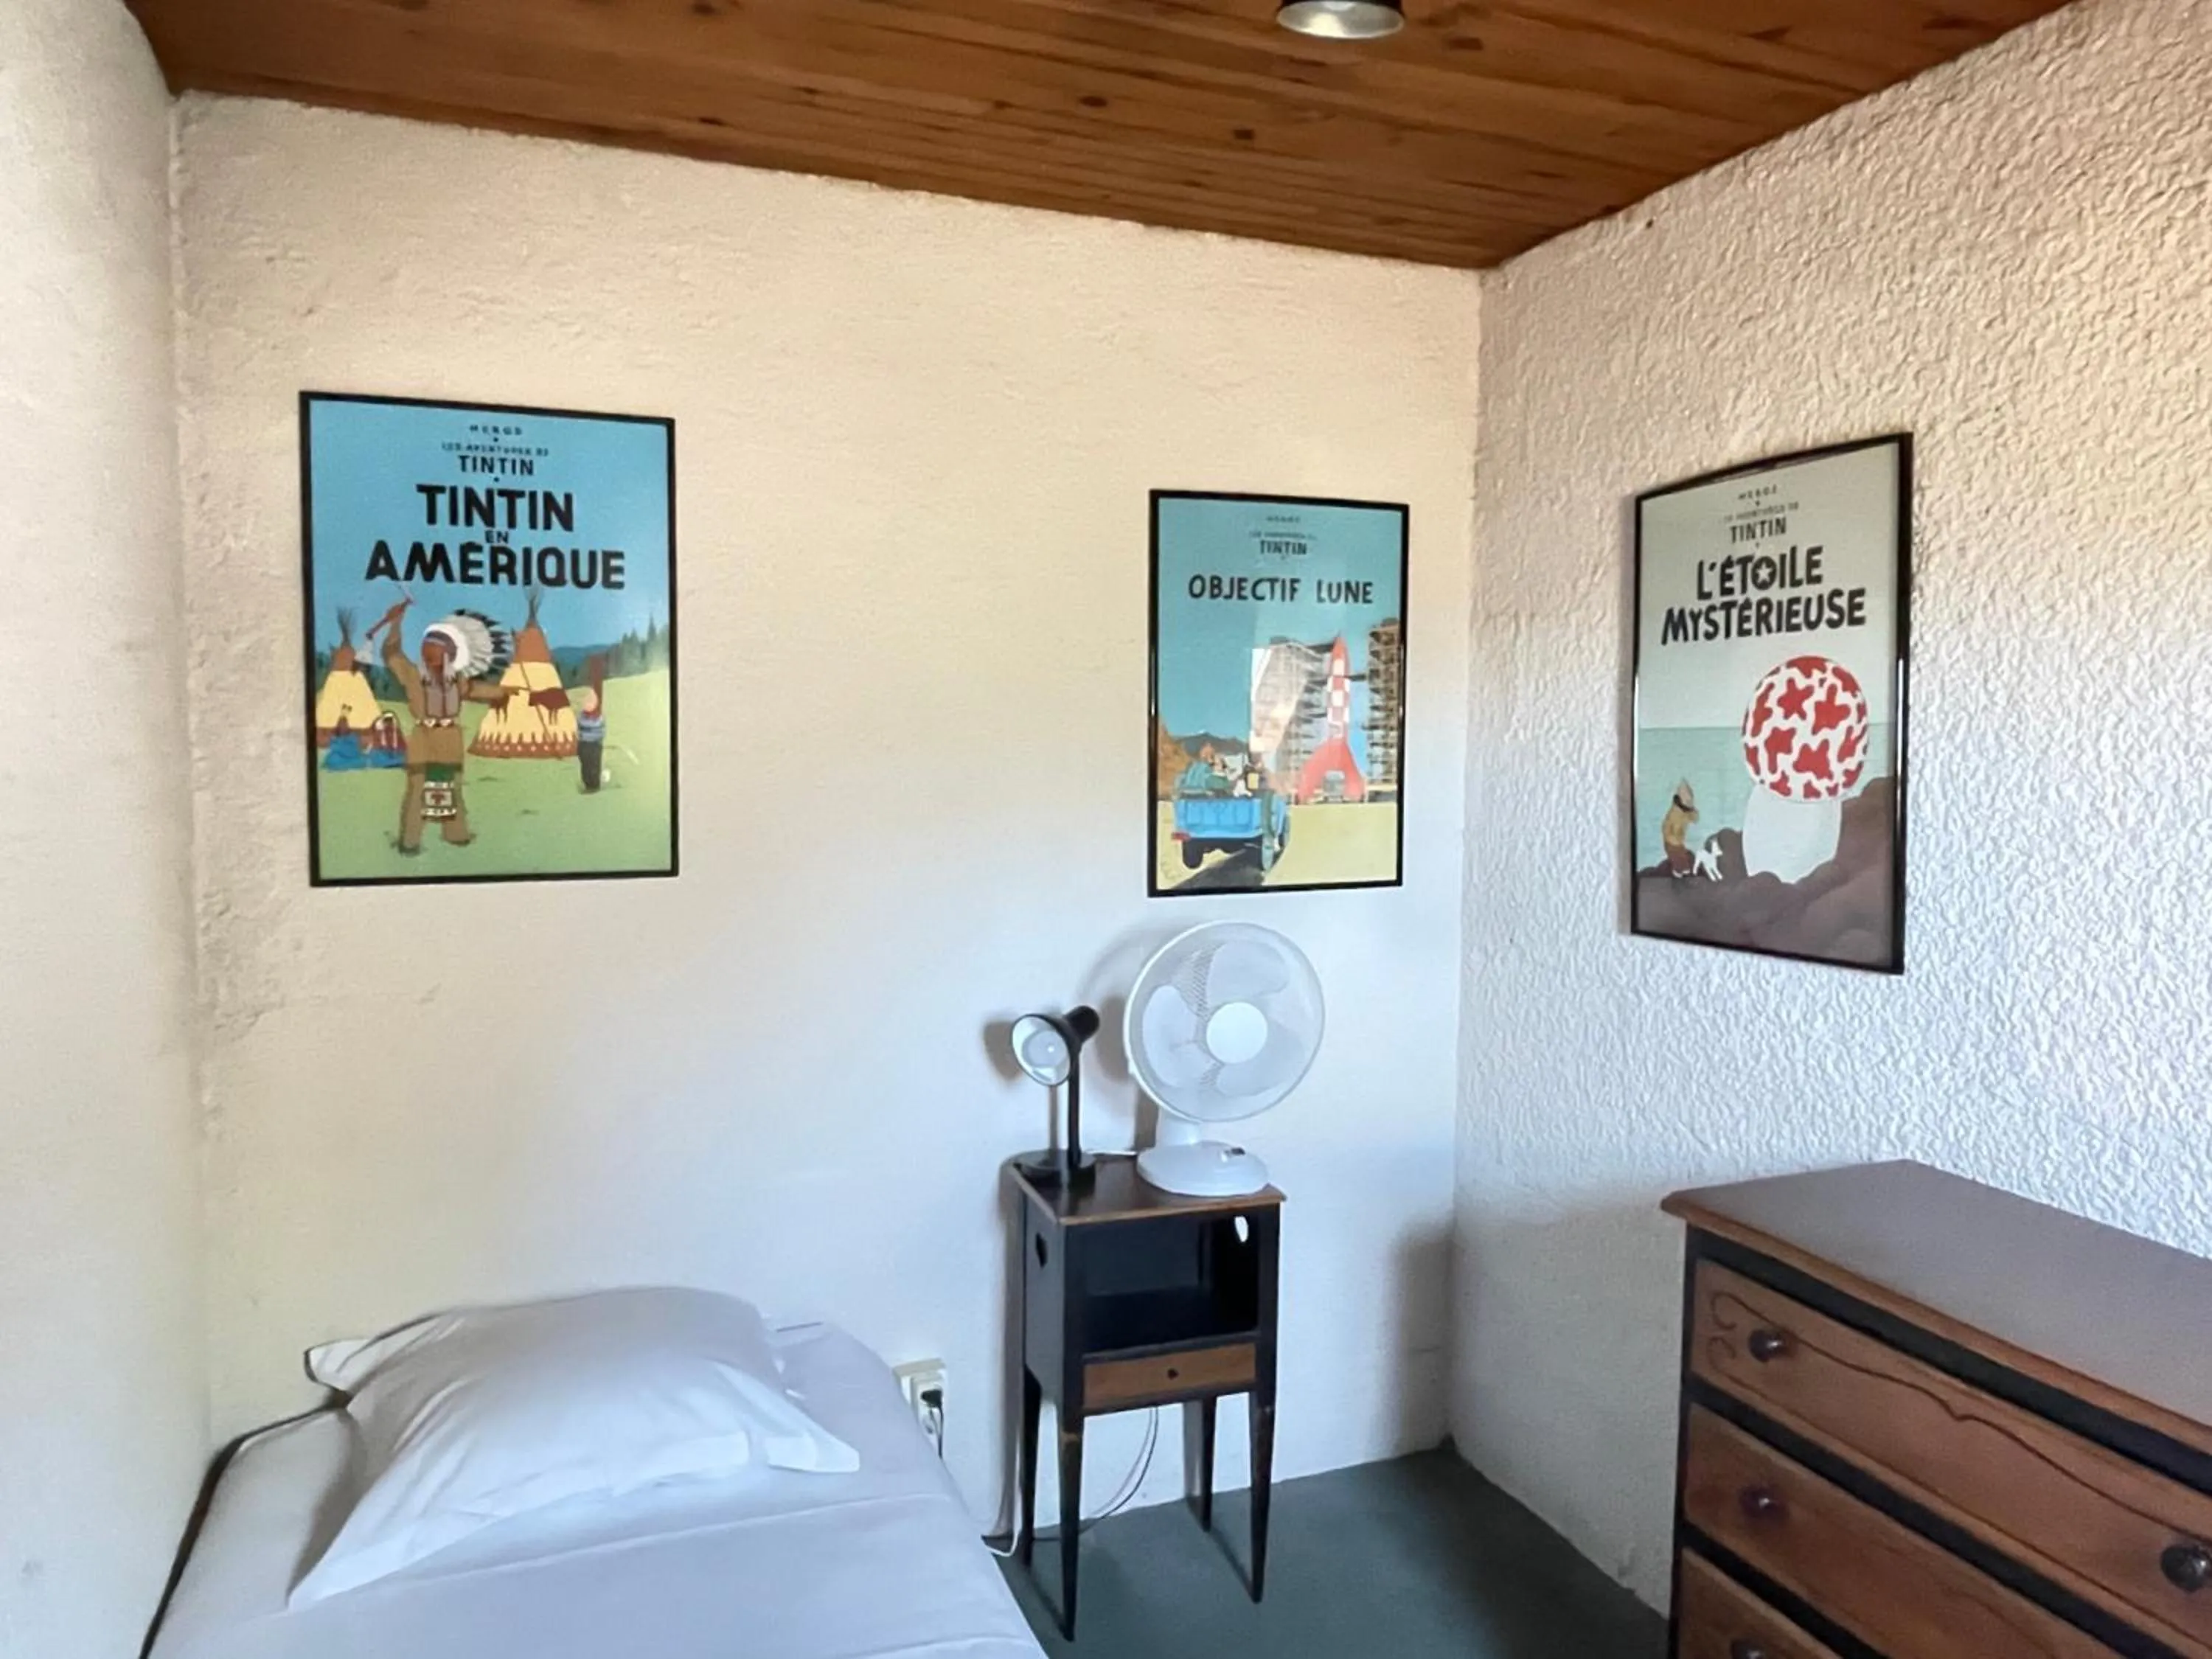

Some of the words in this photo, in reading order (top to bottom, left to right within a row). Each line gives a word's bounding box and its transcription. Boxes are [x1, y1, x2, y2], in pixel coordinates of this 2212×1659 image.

[458, 455, 534, 476] TINTIN
[416, 484, 574, 532] TINTIN
[484, 530, 509, 544] EN
[1730, 516, 1787, 543] TINTIN
[1260, 540, 1307, 554] TINTIN
[365, 540, 625, 589] AMÉRIQUE
[1697, 546, 1823, 600] L'ÉTOILE
[1188, 574, 1301, 602] OBJECTIF
[1316, 580, 1373, 604] LUNE
[1660, 588, 1866, 645] MYSTÉRIEUSE
